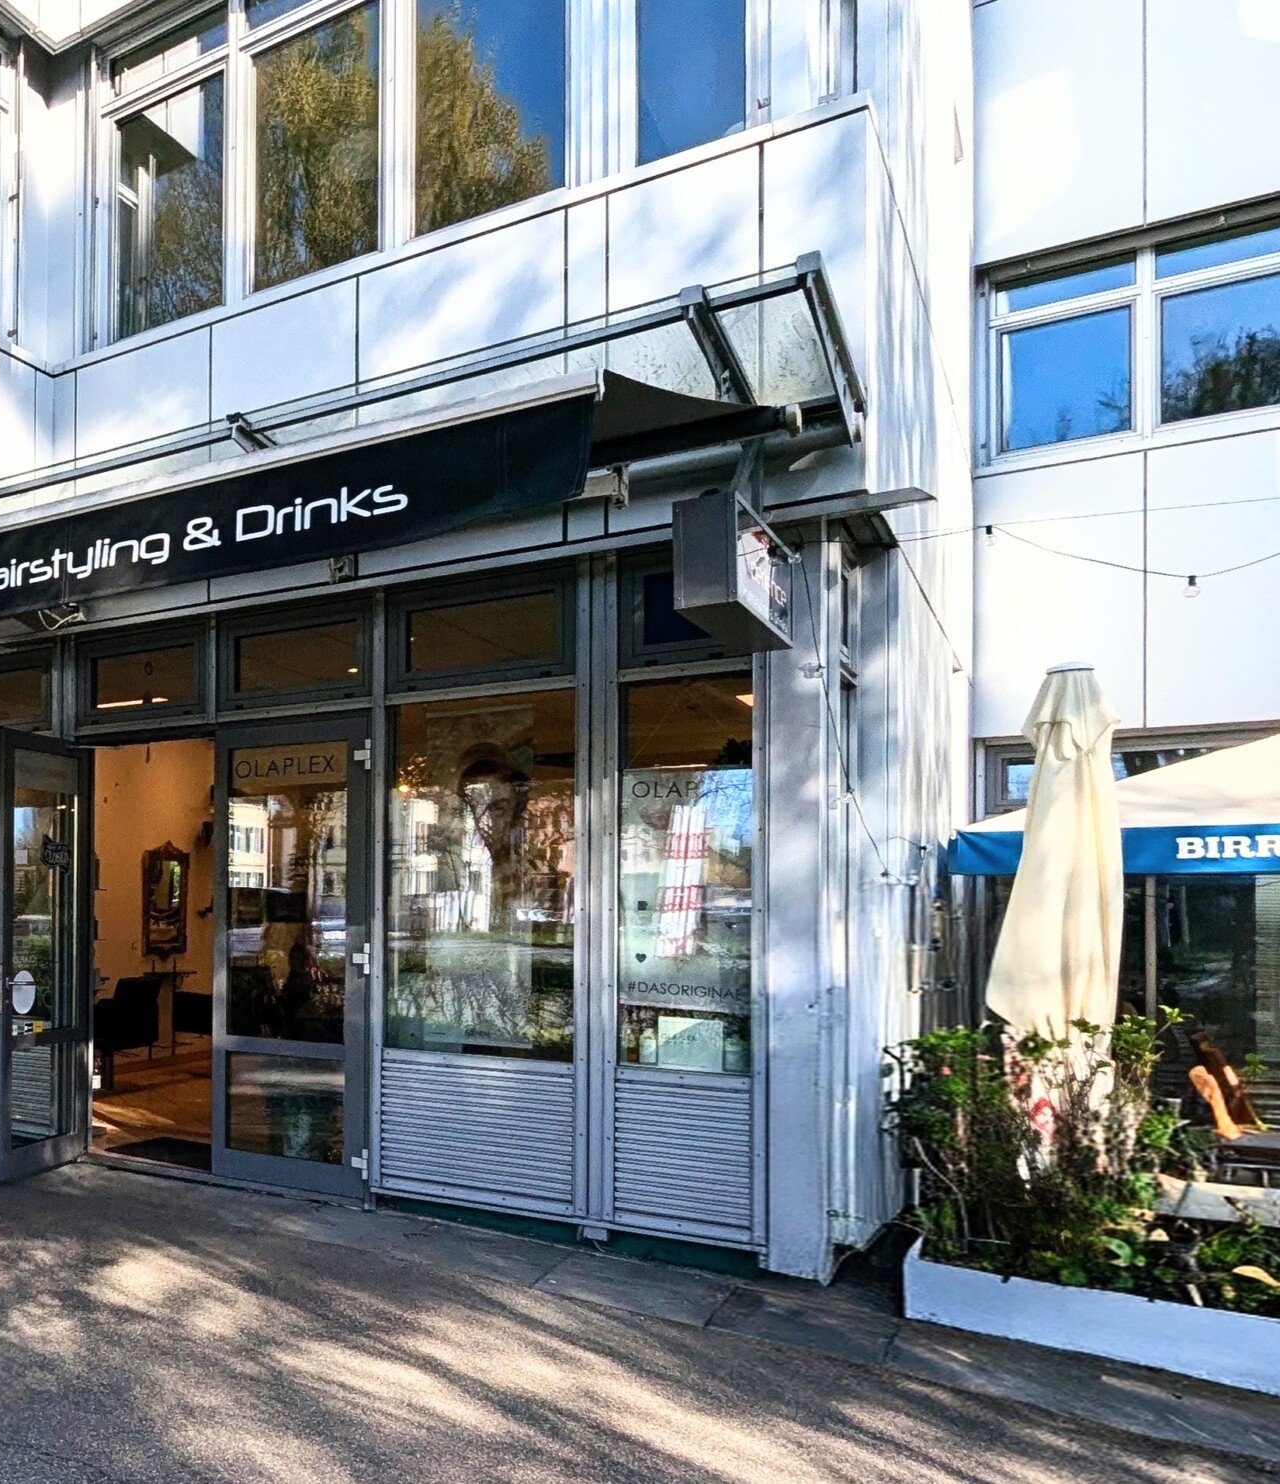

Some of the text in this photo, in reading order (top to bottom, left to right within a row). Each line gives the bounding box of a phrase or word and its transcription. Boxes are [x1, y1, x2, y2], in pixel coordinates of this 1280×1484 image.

[183, 516, 221, 552] &
[235, 484, 408, 542] Drinks
[235, 754, 335, 779] OLAPLEX
[1176, 835, 1280, 859] BIRR
[627, 981, 741, 1001] #DASORIGINAL
